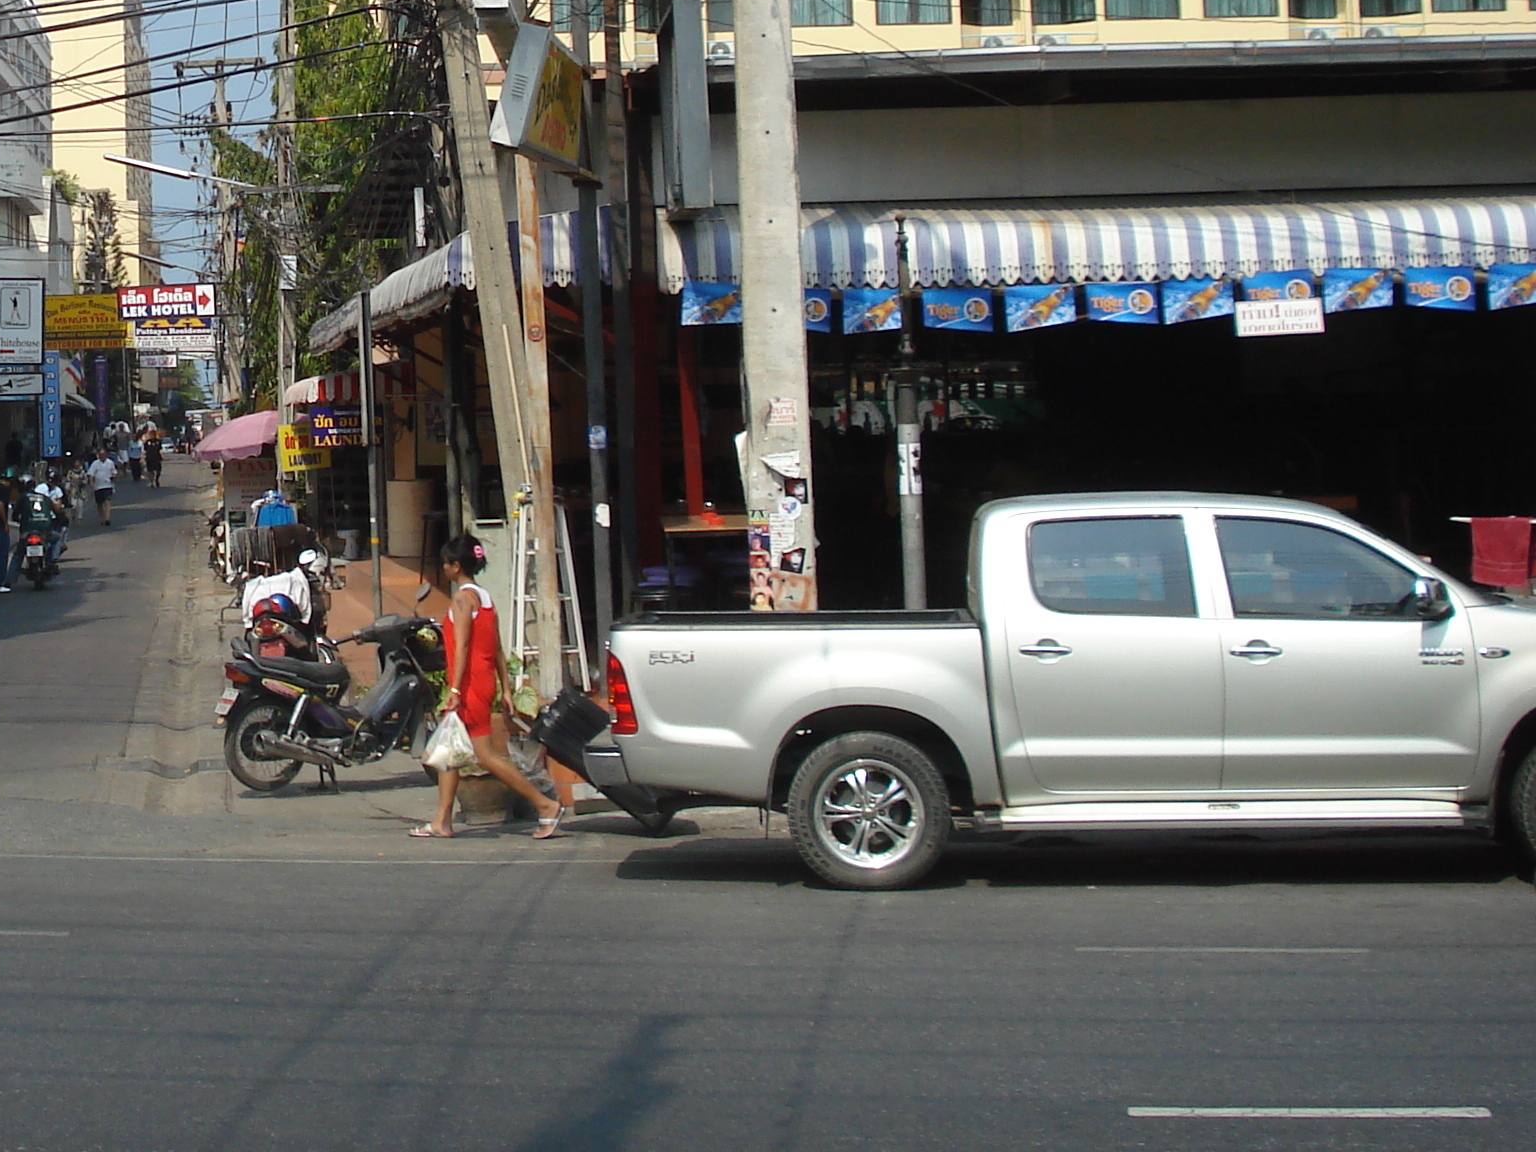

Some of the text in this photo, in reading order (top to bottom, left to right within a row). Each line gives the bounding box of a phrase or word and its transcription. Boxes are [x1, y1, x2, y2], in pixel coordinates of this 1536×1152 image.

[1408, 281, 1443, 297] Tiger
[121, 289, 147, 306] เล็ก
[1090, 296, 1125, 312] Tiger
[122, 306, 148, 318] LEK
[151, 303, 195, 317] HOTEL
[926, 303, 960, 319] Tiger
[135, 327, 168, 336] Pattaya
[169, 327, 212, 336] Residence
[45, 340, 87, 348] MOTORBIKE
[105, 339, 122, 347] RENT
[314, 434, 383, 447] LAUNDY
[288, 452, 322, 467] LAUNDRY
[326, 683, 340, 699] 27
